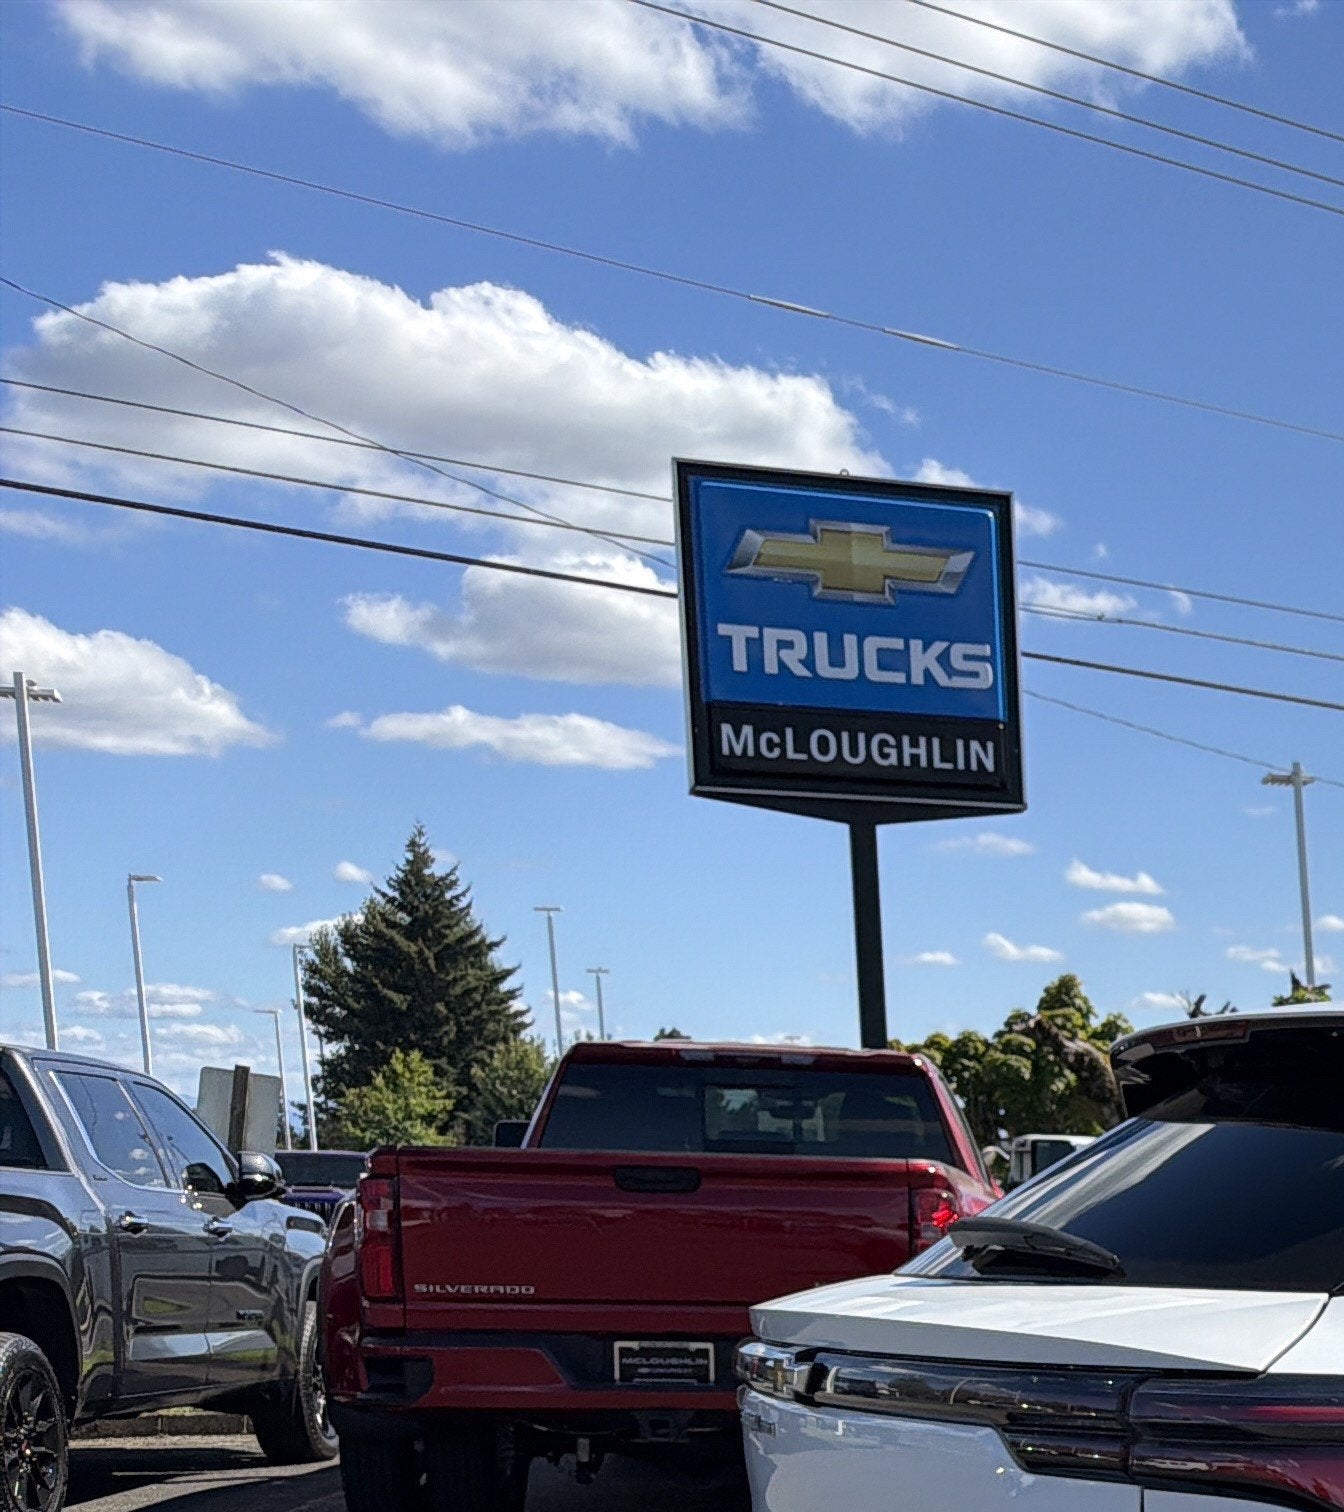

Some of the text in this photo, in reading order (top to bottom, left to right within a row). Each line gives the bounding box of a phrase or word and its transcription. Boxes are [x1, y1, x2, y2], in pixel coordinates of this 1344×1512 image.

[717, 623, 994, 689] TRUCKS
[720, 722, 995, 772] McLOUGHLIN
[413, 1283, 536, 1295] SILVERADO
